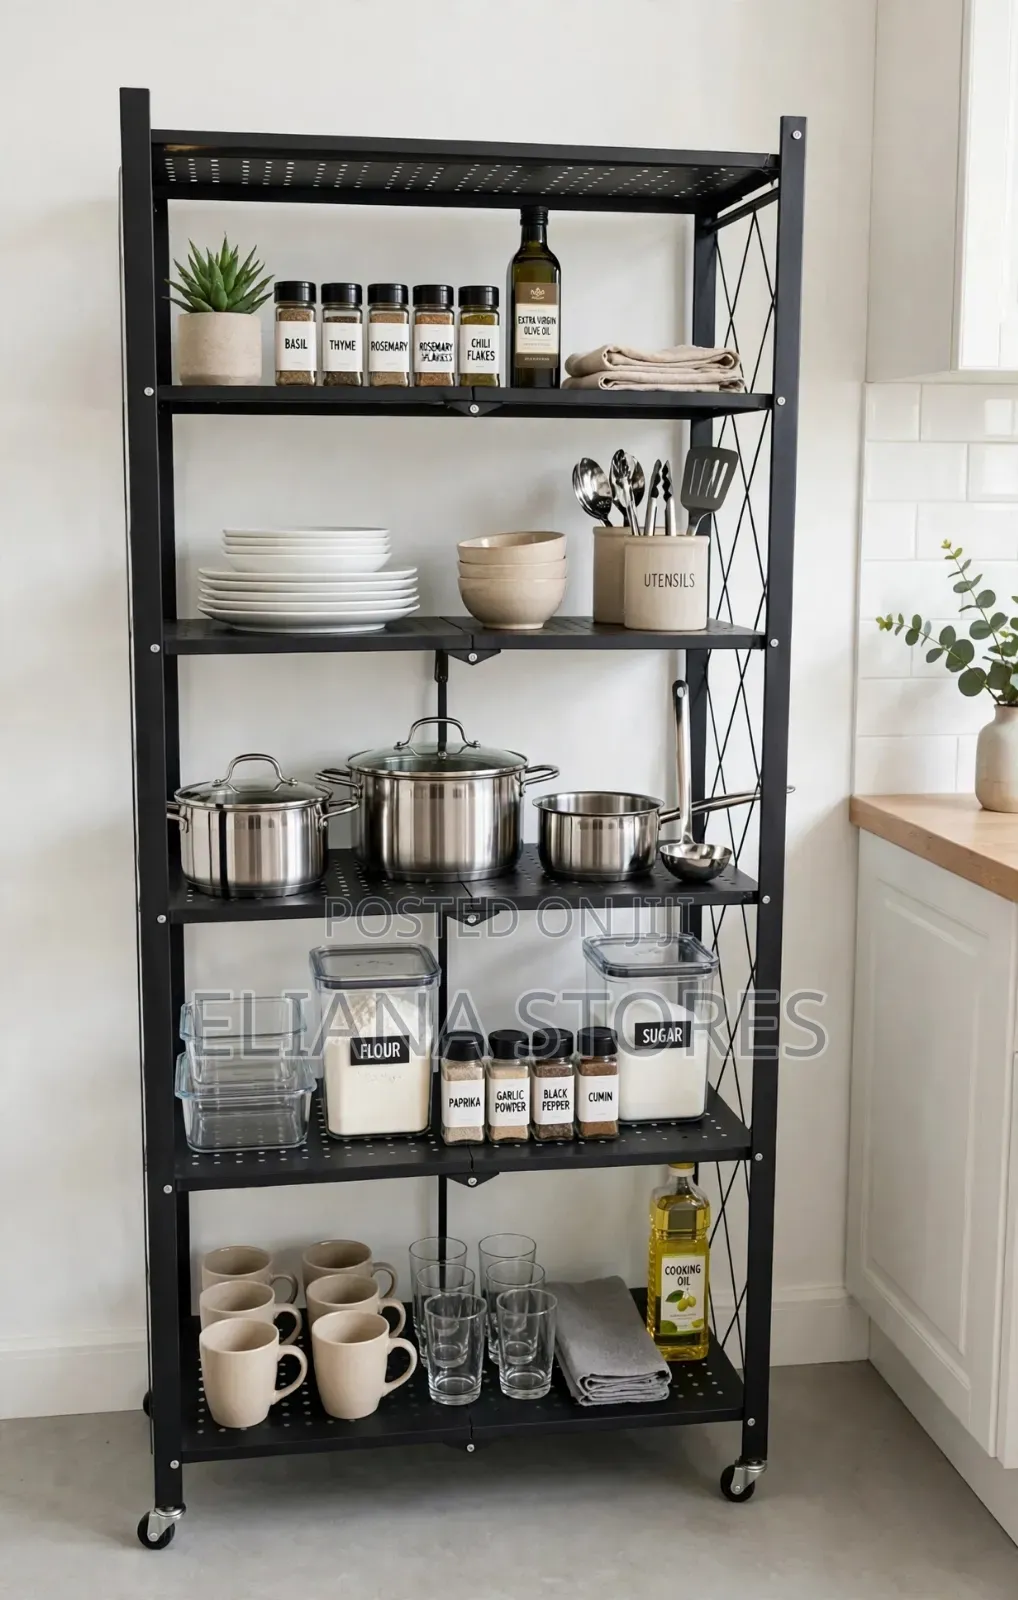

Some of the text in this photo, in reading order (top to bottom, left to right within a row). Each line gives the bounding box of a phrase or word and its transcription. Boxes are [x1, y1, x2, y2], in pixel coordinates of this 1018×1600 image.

[518, 315, 556, 325] EXTRA VIRGIN
[524, 326, 551, 336] OLIVE OIL
[285, 338, 308, 349] BASIL
[330, 340, 356, 351] THYME
[370, 340, 408, 352] ROSEMARY
[471, 338, 491, 348] CHILI
[467, 350, 496, 361] FLAKES
[644, 573, 695, 588] UTENSILS
[642, 1027, 683, 1044] SUGAR
[360, 1043, 400, 1060] FLOUR
[496, 1090, 524, 1102] GARLIC
[543, 1088, 568, 1100] BLACK
[588, 1091, 612, 1103] CUMIN
[448, 1096, 481, 1109] PAPRIKA
[495, 1102, 526, 1113] POWDER
[542, 1100, 570, 1112] PEPPER
[664, 1264, 701, 1276] COOKING
[677, 1276, 691, 1286] OIL
